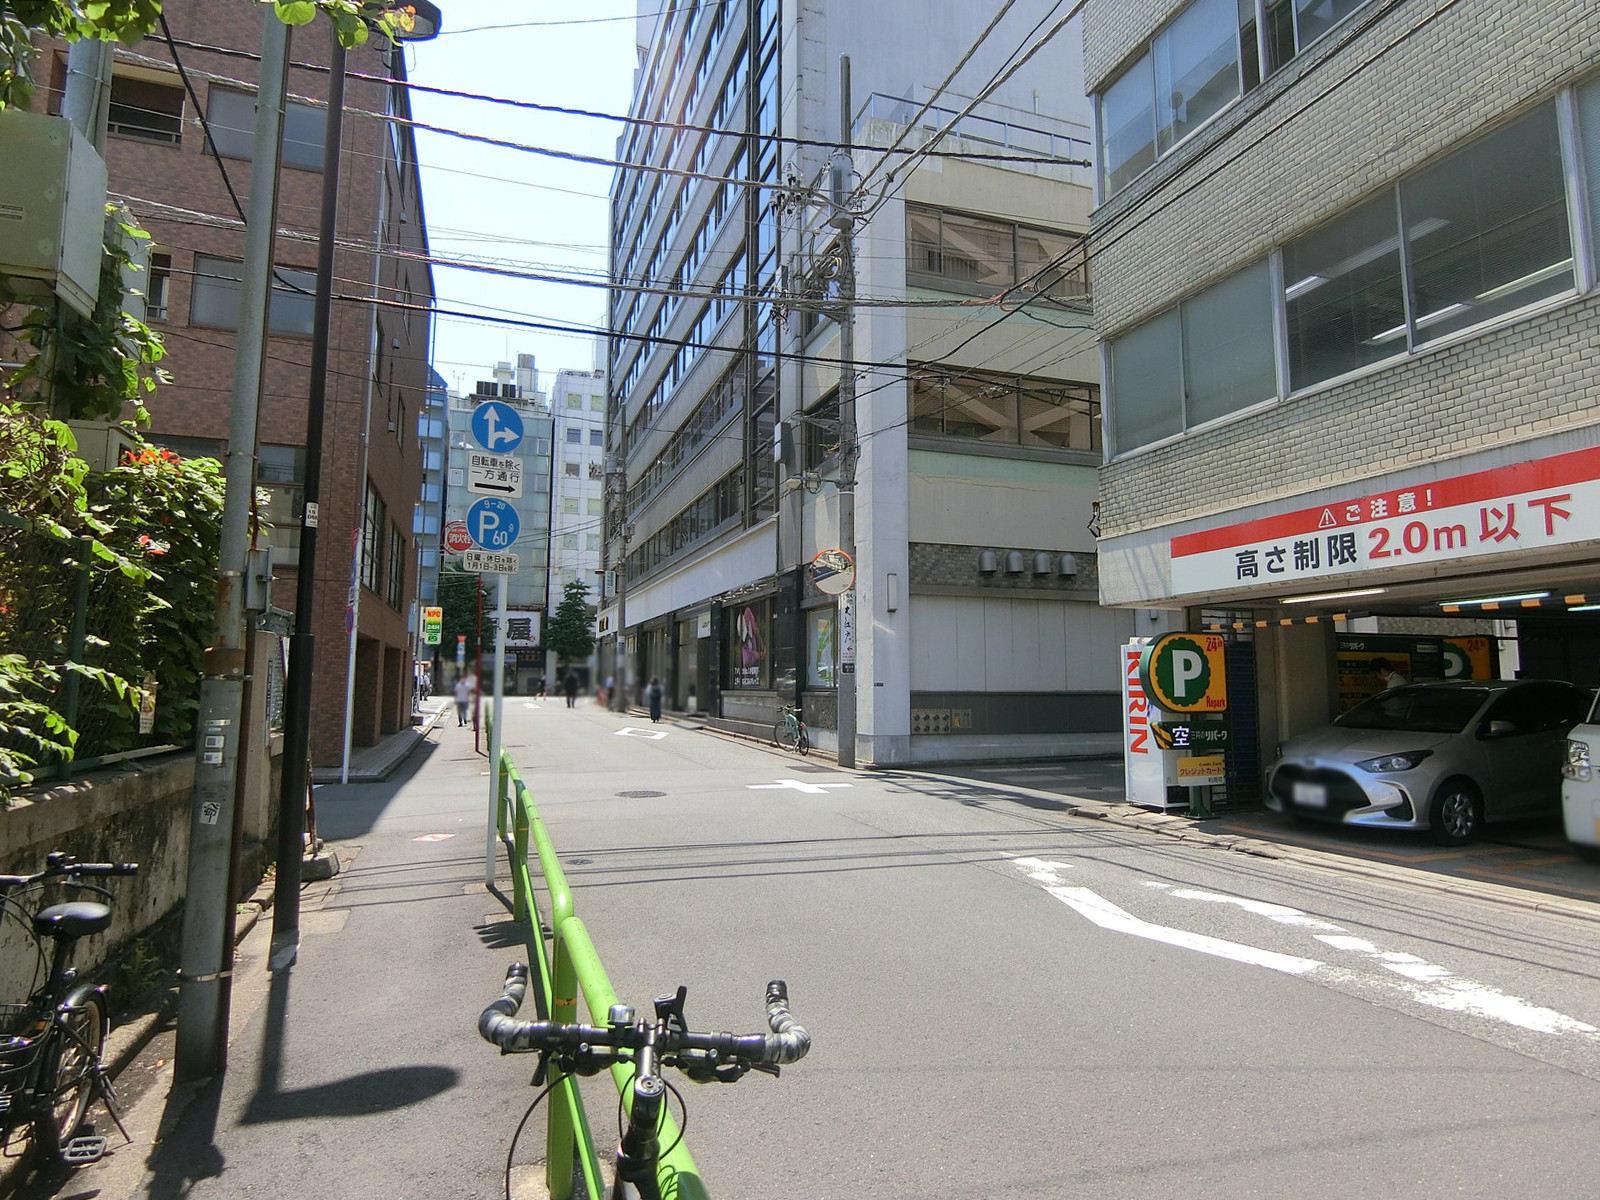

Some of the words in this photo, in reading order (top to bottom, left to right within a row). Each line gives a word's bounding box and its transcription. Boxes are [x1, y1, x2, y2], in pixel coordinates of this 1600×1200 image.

[471, 455, 521, 470] 自転車を除く
[471, 469, 520, 483] 一方通行
[1345, 489, 1432, 522] ご注意!
[479, 510, 500, 543] P
[1171, 649, 1202, 698] P
[1126, 651, 1148, 754] KIRIN
[1205, 695, 1226, 709] Repark
[1172, 725, 1189, 746] 空
